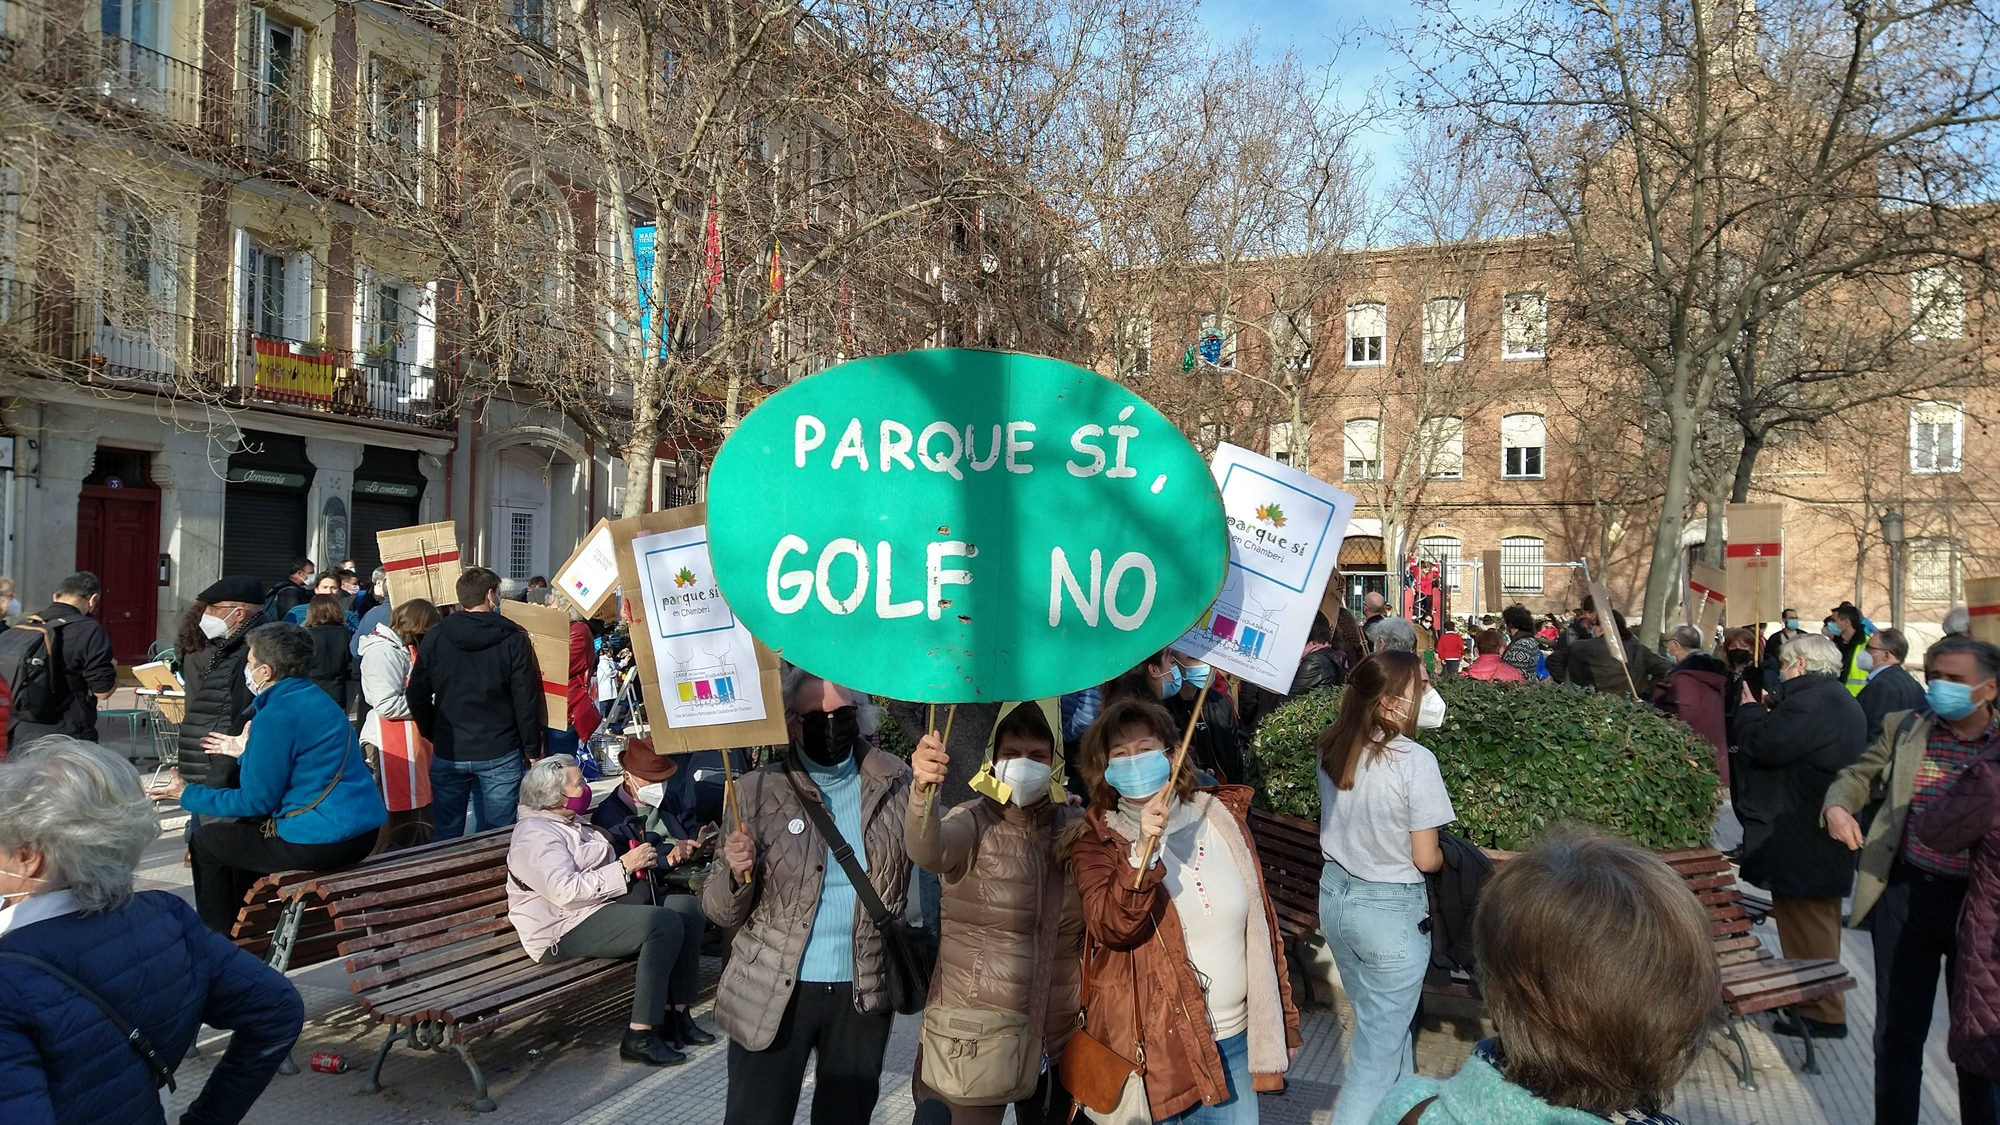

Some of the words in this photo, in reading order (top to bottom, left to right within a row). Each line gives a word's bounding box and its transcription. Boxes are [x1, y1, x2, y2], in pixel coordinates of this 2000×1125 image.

[794, 414, 1037, 481] PARQUE
[110, 479, 119, 489] 3
[243, 469, 286, 485] Cervecería
[364, 481, 379, 493] La
[378, 485, 408, 495] contenta
[1231, 534, 1243, 545] en
[1290, 541, 1309, 557] sí
[766, 534, 979, 621] GOLF
[1048, 546, 1157, 632] NO
[661, 590, 707, 612] parque
[708, 584, 720, 599] sí
[672, 609, 681, 618] en
